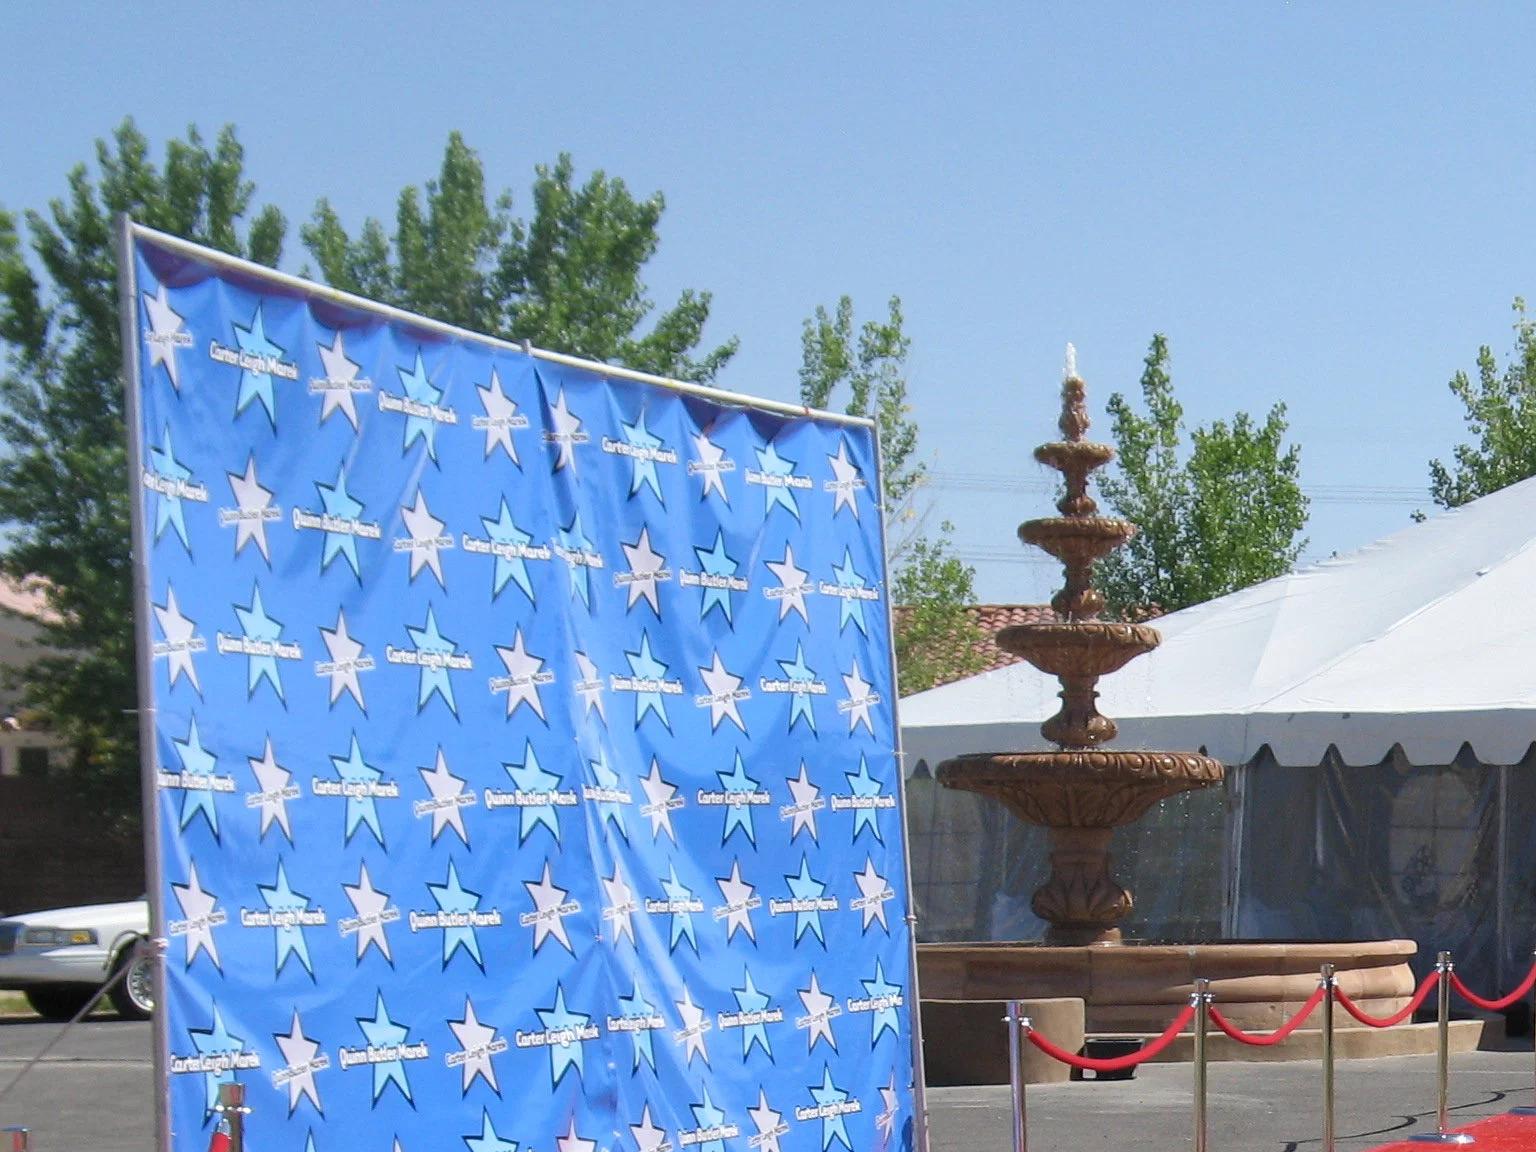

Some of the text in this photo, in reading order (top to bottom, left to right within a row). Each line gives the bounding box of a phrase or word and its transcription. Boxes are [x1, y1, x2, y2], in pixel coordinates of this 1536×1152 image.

[463, 536, 491, 554] Carter
[519, 542, 551, 560] Marek
[386, 646, 417, 665] Carter
[443, 651, 473, 670] Marek
[760, 678, 790, 692] Carter
[312, 777, 341, 796] Carter
[370, 780, 399, 797] Marek
[699, 790, 724, 804] Carter
[746, 791, 770, 804] Marek
[485, 790, 515, 809] Quinn
[517, 790, 548, 805] Butler
[241, 909, 327, 930] Carter Leigh Marek
[409, 909, 501, 932] Quinn Butler Marek
[517, 1030, 545, 1047] Carter
[546, 1027, 574, 1048] Leigh
[171, 1053, 260, 1077] Carter Leigh Marek
[340, 1042, 428, 1069] Quinn Butler Marek
[796, 1106, 819, 1121] Carter
[839, 1101, 861, 1115] Marek
